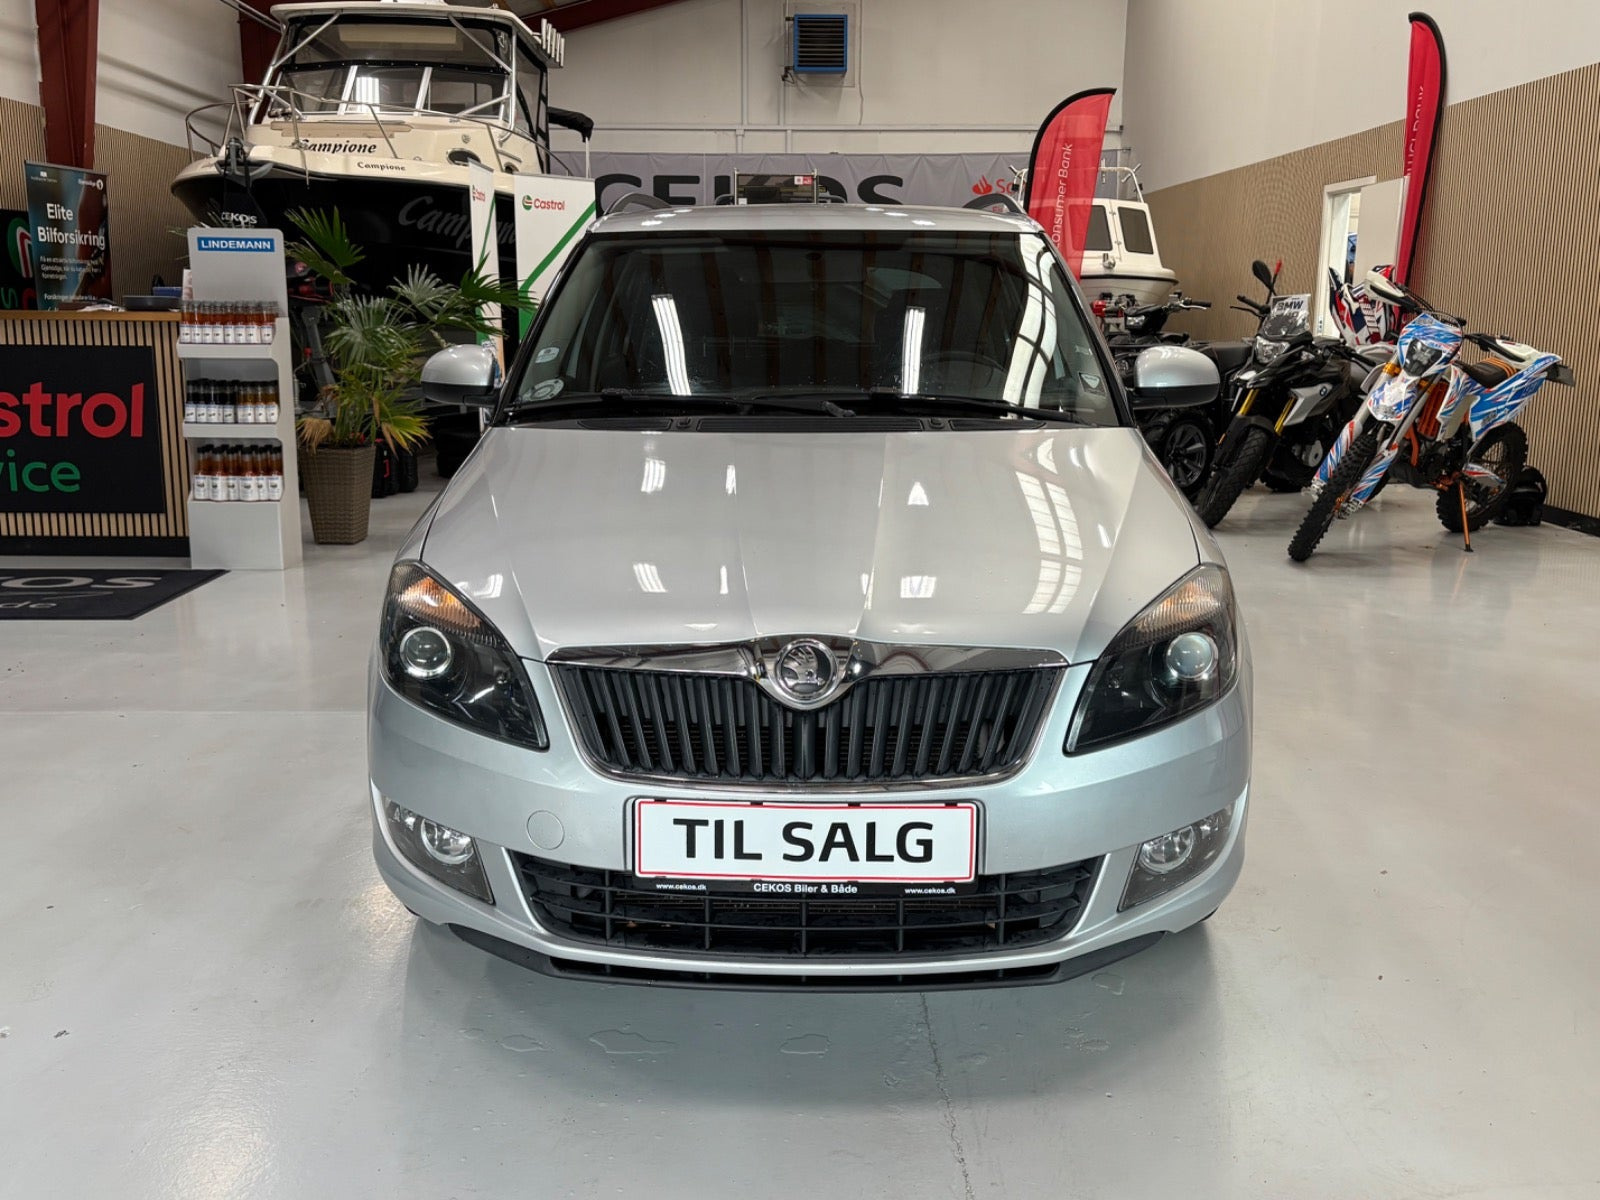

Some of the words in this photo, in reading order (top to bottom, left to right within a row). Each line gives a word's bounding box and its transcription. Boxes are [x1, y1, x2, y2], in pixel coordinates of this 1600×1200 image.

[357, 161, 406, 171] Campione
[1058, 143, 1073, 179] Bank
[533, 198, 565, 210] Castrol
[46, 203, 74, 221] Elite
[1051, 180, 1067, 249] onsumer
[37, 226, 106, 250] Bilforsikring
[201, 240, 271, 249] LINDEMANN
[672, 818, 763, 861] TIL
[782, 821, 934, 864] SALG
[656, 883, 707, 891] www.cekos.dk
[753, 883, 792, 893] CEKOS
[794, 883, 817, 893] Biler
[821, 884, 829, 893] &
[831, 884, 858, 894] Både
[904, 886, 956, 895] www.cekos.dk
